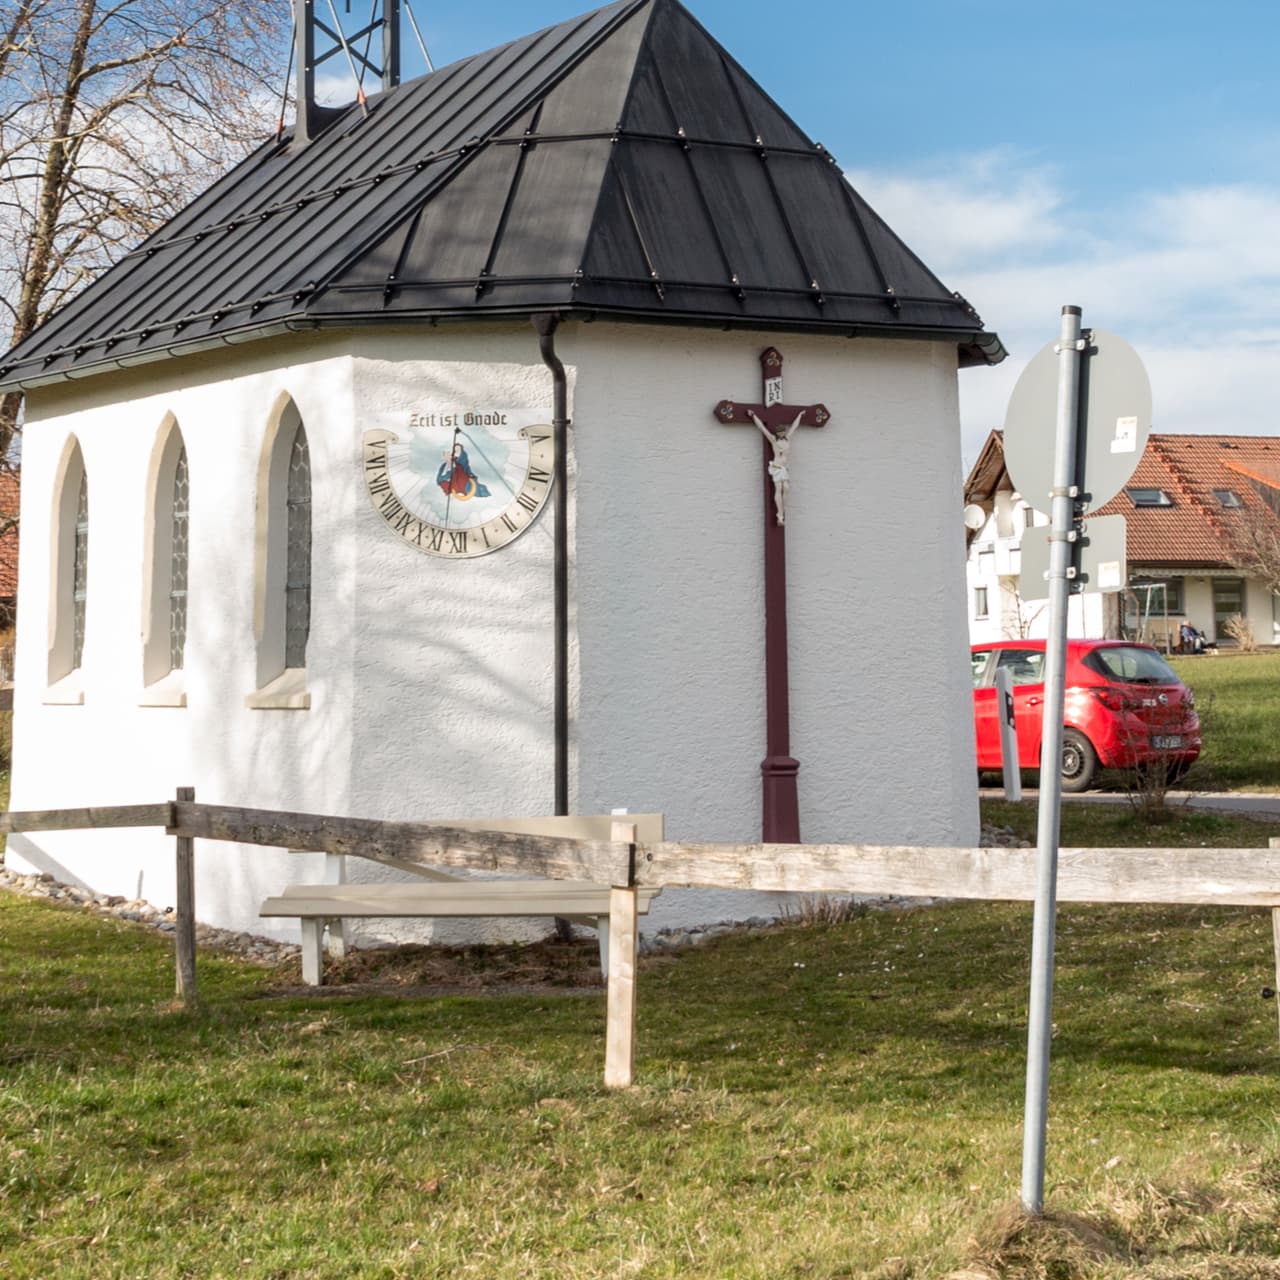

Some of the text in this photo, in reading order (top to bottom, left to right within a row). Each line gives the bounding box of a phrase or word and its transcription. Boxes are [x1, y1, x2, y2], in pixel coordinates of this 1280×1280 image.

[409, 410, 507, 427] Zeit ist Gnade
[365, 455, 386, 471] VI
[368, 473, 389, 495] VII
[528, 466, 551, 483] IV
[378, 493, 402, 521] VIII
[516, 493, 539, 514] III
[396, 511, 415, 536] IX
[501, 513, 518, 533] II
[411, 522, 428, 546] X
[428, 527, 445, 552] XI
[449, 531, 468, 553] XII
[480, 527, 491, 548] I
